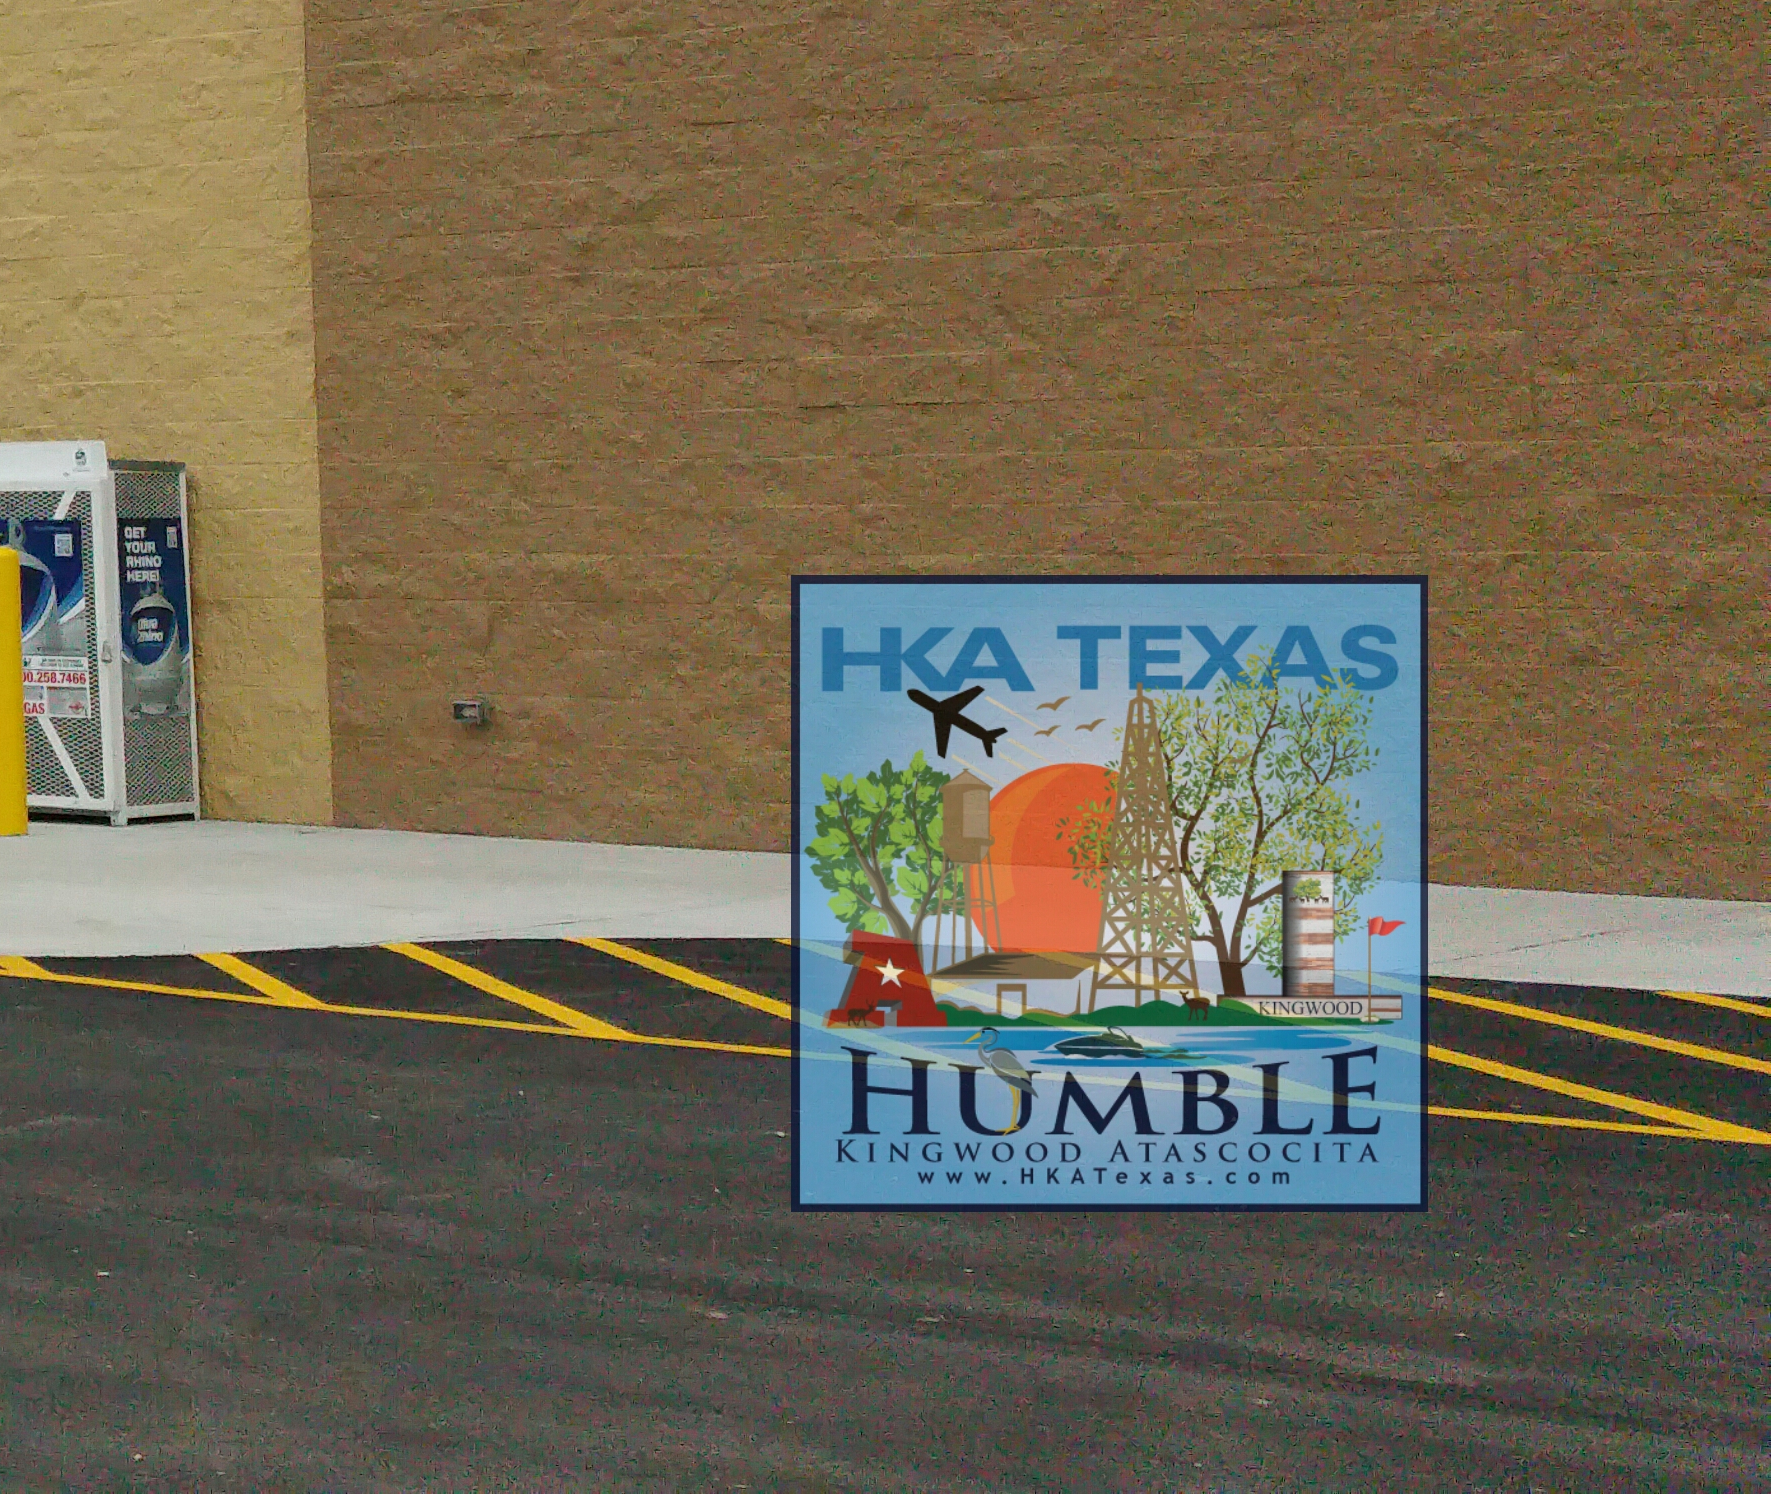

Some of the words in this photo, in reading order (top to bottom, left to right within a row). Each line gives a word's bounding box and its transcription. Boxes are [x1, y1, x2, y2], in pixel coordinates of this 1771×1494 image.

[124, 540, 157, 554] YOUR
[125, 555, 162, 568] RHINO
[23, 702, 46, 715] GAS
